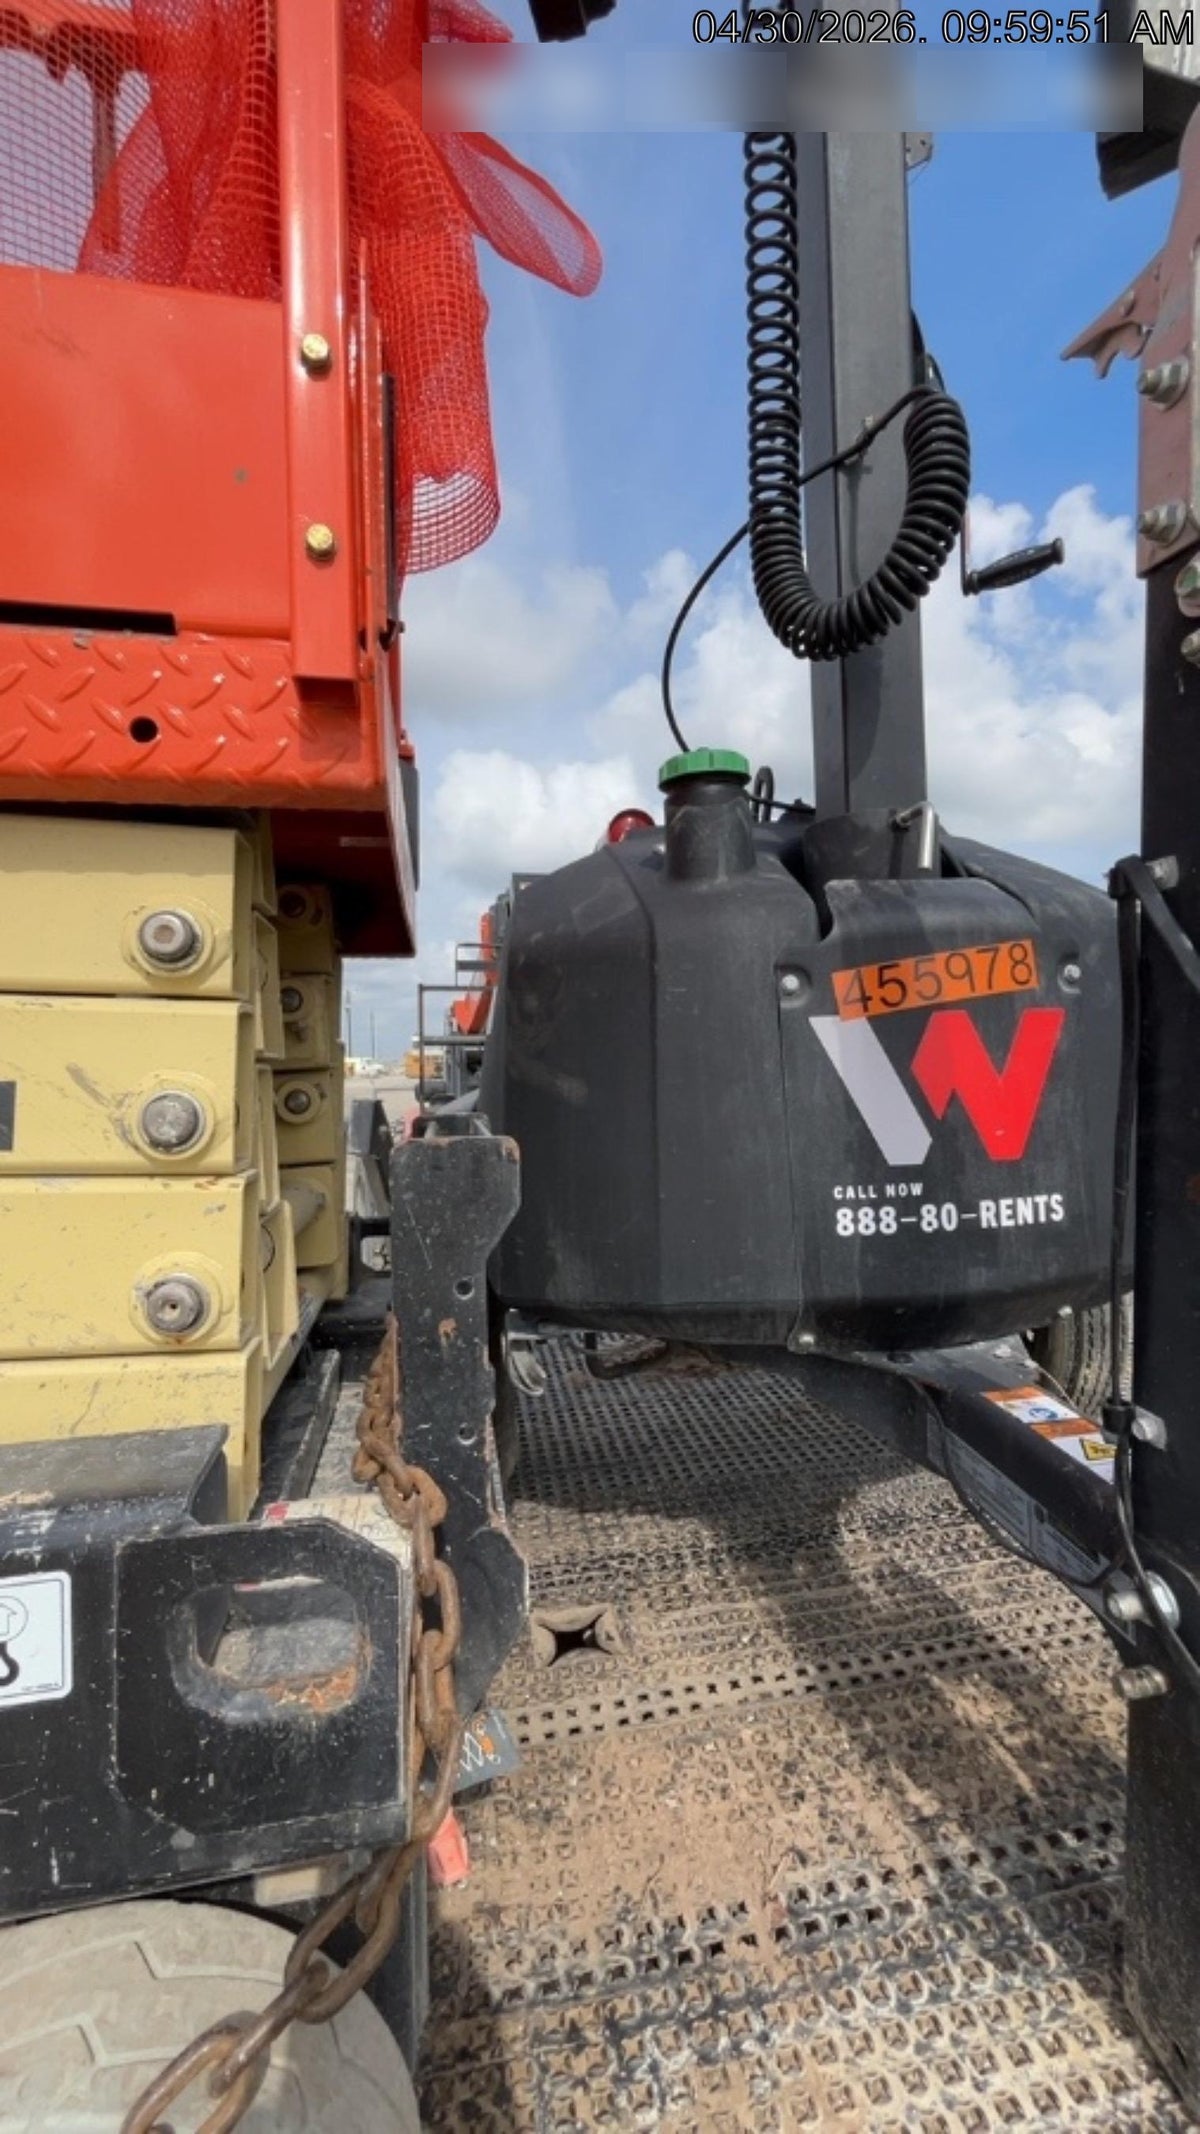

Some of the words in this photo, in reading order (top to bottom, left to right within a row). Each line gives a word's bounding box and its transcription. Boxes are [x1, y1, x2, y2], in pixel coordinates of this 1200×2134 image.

[842, 943, 1033, 1013] 455978
[833, 1184, 878, 1199] CALL
[886, 1182, 924, 1197] NOW
[836, 1194, 1065, 1237] 888-80-RENTS
